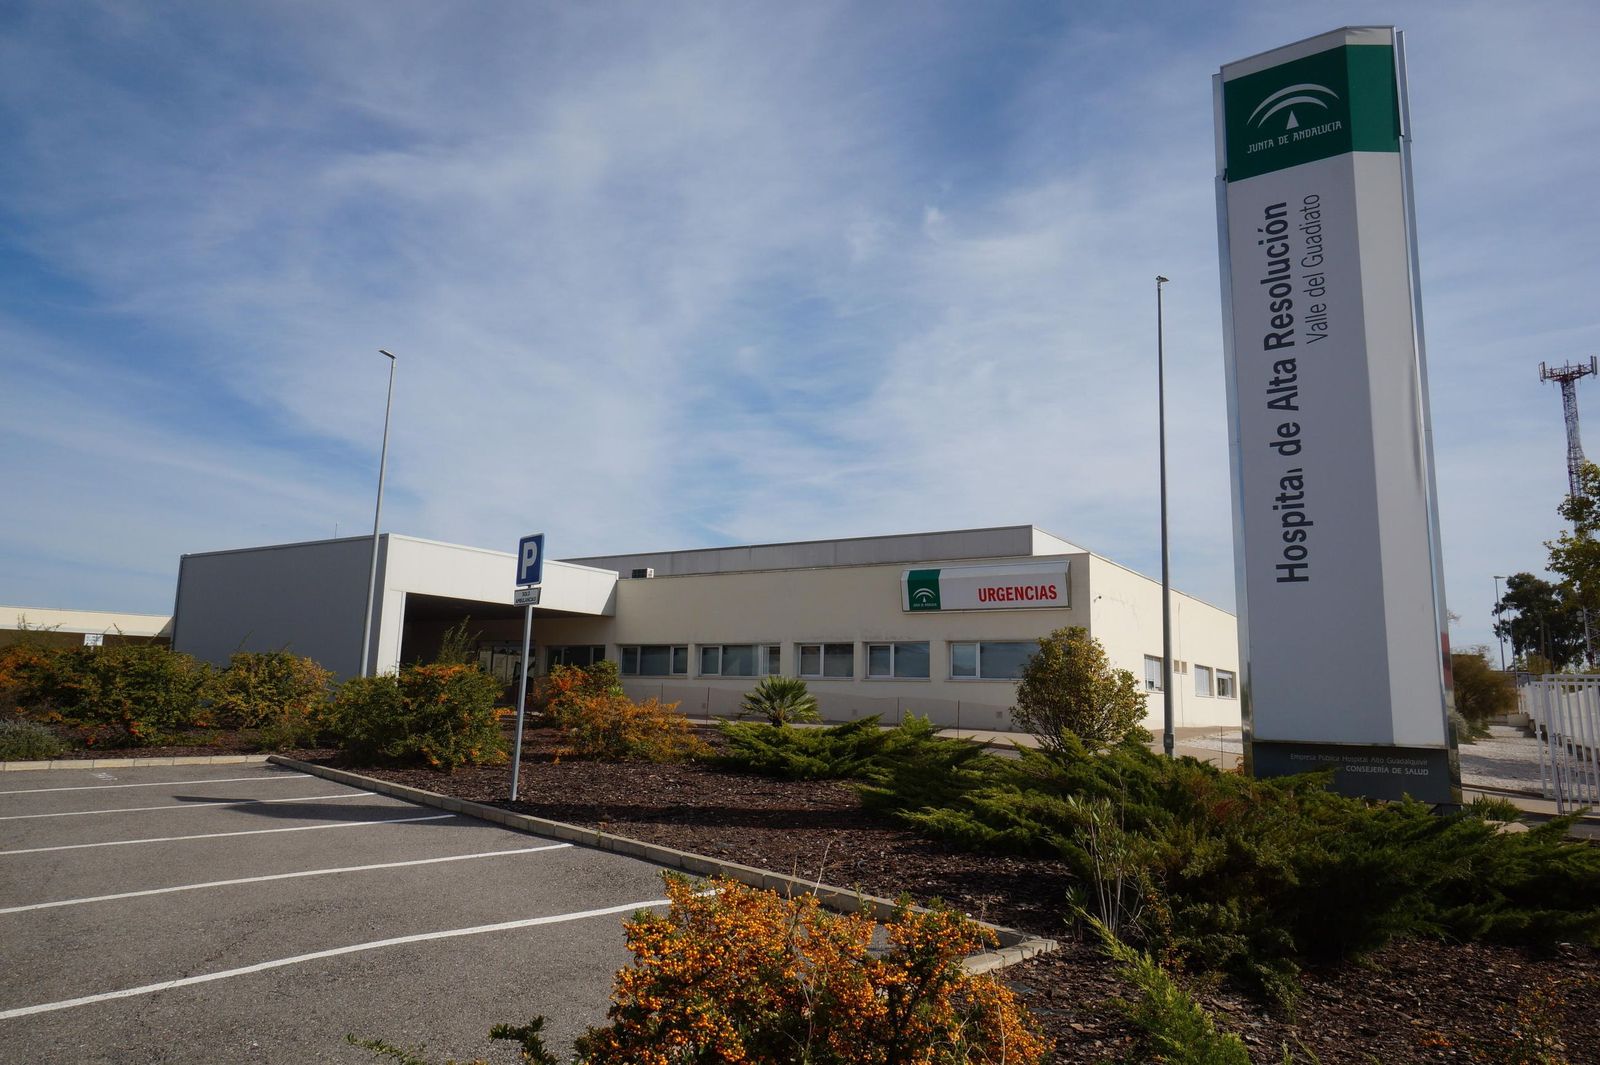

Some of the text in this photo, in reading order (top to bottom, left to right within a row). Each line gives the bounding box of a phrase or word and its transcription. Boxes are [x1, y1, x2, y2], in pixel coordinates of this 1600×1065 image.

[1247, 139, 1275, 154] JUNTA
[1278, 134, 1290, 146] DE
[1257, 201, 1296, 351] Resolución
[1299, 194, 1329, 344] Valle del Guadiato
[1266, 357, 1299, 412] Alta
[1269, 421, 1302, 457] de
[521, 541, 538, 579] P
[978, 584, 1058, 603] URGENCIAS
[1404, 767, 1429, 776] SALUD
